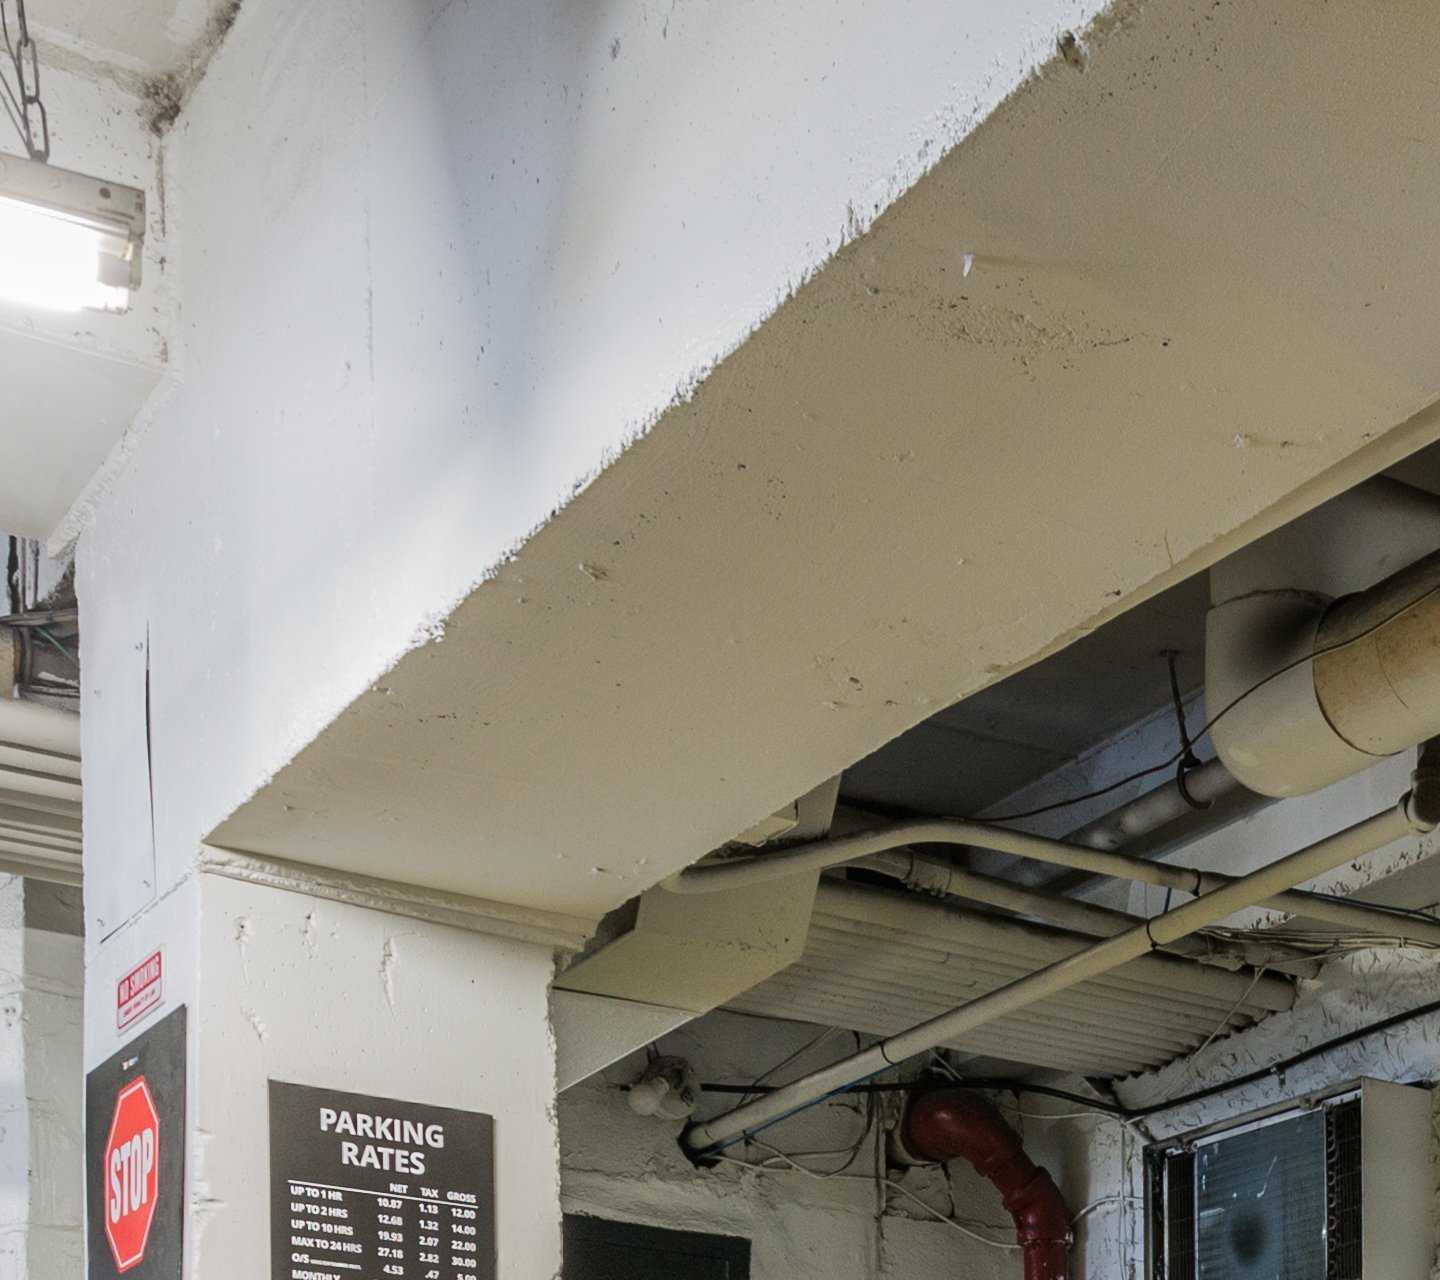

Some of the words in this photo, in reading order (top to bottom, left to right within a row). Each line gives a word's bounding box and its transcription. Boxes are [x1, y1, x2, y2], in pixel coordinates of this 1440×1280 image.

[129, 953, 160, 999] SMOKING
[319, 1108, 445, 1149] PARKING
[341, 1141, 426, 1175] RATES
[110, 1127, 154, 1225] STOP
[290, 1185, 305, 1196] UP
[305, 1188, 320, 1198] TO
[321, 1190, 327, 1199] 1
[328, 1191, 343, 1202] HR
[419, 1203, 439, 1214] 1.13
[451, 1208, 476, 1219] 12.00
[389, 1183, 408, 1194] NET
[420, 1187, 439, 1199] TAX
[446, 1191, 477, 1204] GROSS
[290, 1202, 305, 1212] UP
[305, 1204, 320, 1215] TO
[320, 1206, 328, 1216] 2
[328, 1208, 349, 1219] HRS
[419, 1219, 439, 1231] 1.32
[451, 1224, 476, 1236] 14.00
[290, 1219, 305, 1229] UP
[306, 1221, 320, 1232] TO
[321, 1223, 333, 1234] 10
[334, 1225, 354, 1236] HRS
[418, 1236, 439, 1247] 2.07
[451, 1240, 476, 1252] 22.00
[291, 1236, 315, 1247] MAX
[315, 1238, 329, 1249] TO
[330, 1240, 342, 1251] 24
[342, 1243, 362, 1254] HRS
[377, 1247, 404, 1259] 27.18
[419, 1252, 439, 1264] 2.82
[451, 1256, 476, 1268] 30.00
[291, 1252, 309, 1264] O/S
[383, 1264, 404, 1275] 4.53
